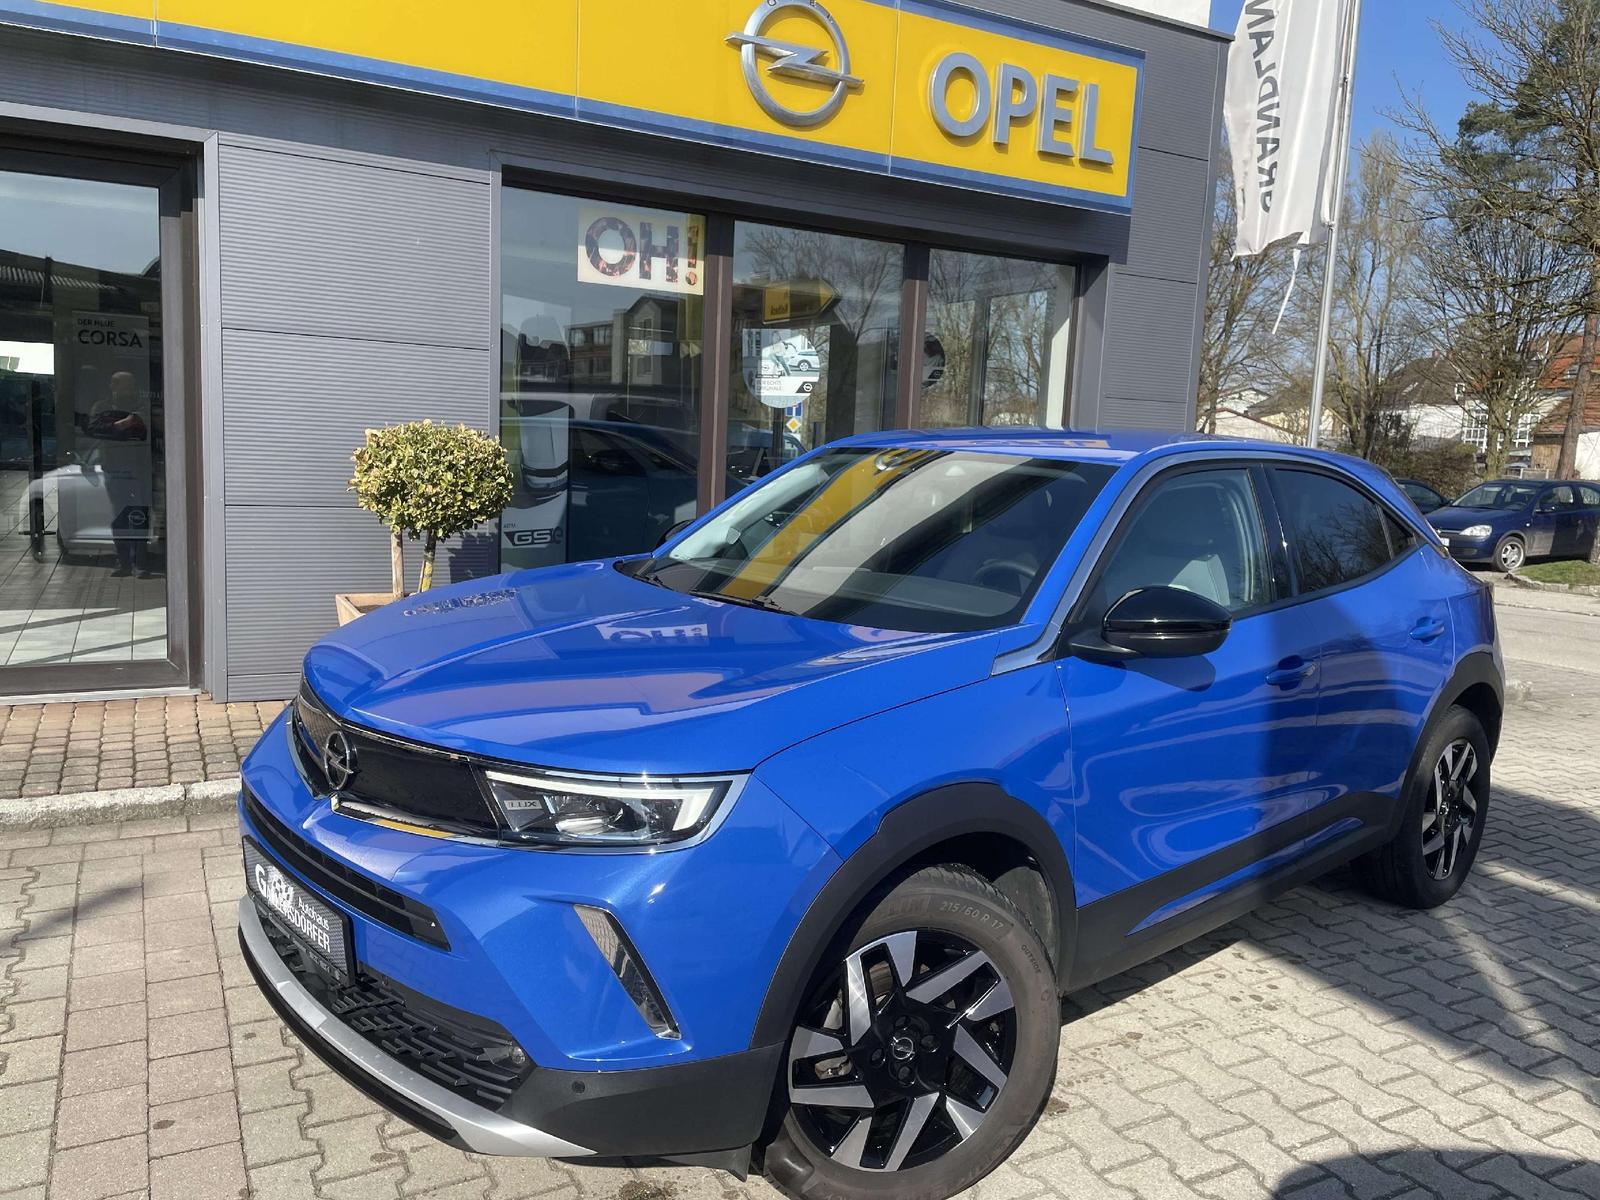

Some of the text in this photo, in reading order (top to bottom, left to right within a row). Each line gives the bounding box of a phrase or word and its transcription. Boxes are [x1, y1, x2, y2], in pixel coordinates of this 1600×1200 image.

[928, 52, 1114, 166] OPEL
[585, 216, 699, 286] OH!
[78, 329, 143, 348] CORSA
[298, 896, 330, 931] Autohaus
[939, 900, 980, 918] 215/60
[981, 913, 990, 923] R
[991, 919, 1005, 930] 17
